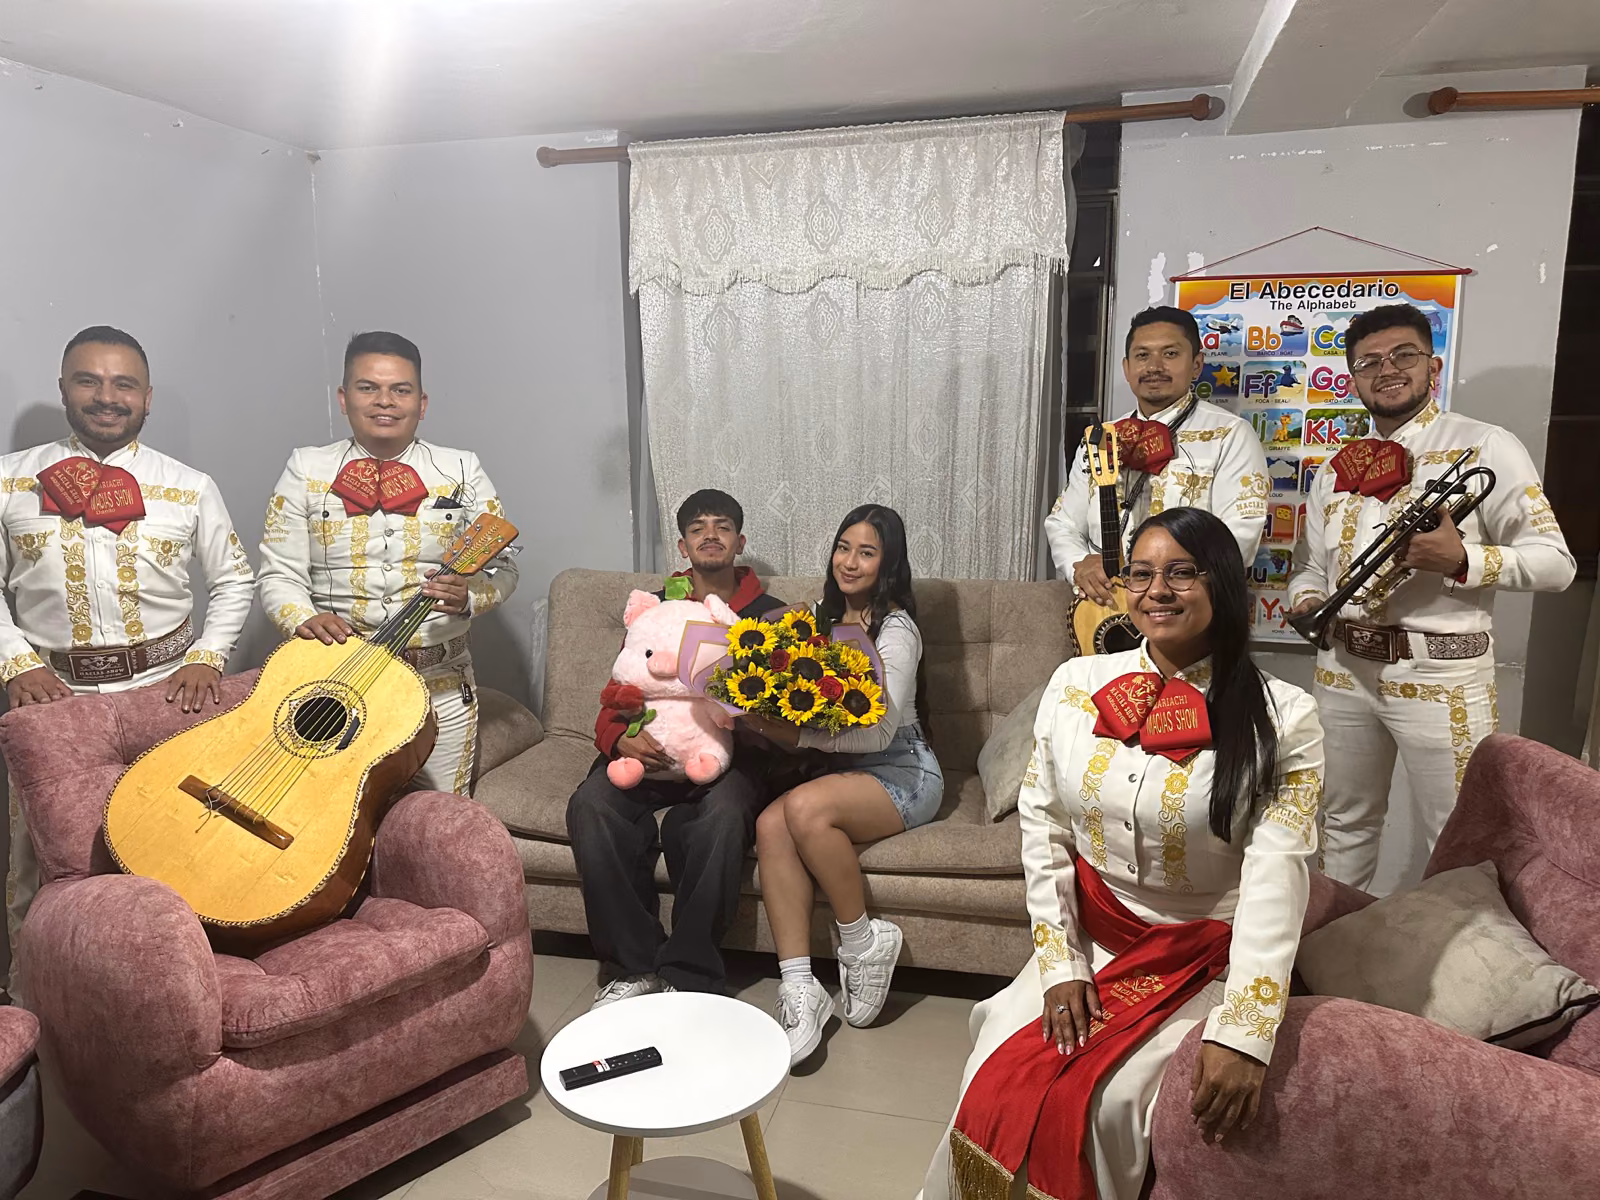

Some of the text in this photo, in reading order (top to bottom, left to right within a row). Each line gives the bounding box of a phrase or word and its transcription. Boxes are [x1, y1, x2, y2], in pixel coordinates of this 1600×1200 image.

[1230, 279, 1399, 300] El Abecedario
[1270, 299, 1356, 312] The Alphabet
[1200, 333, 1219, 349] a
[1247, 326, 1281, 350] Bb
[1244, 374, 1276, 398] Ff
[1312, 366, 1350, 398] Gg
[1306, 420, 1341, 444] Kk
[97, 479, 125, 489] ARIACHI
[114, 487, 134, 508] SHOW
[1146, 708, 1198, 735] MACIAS SHOW
